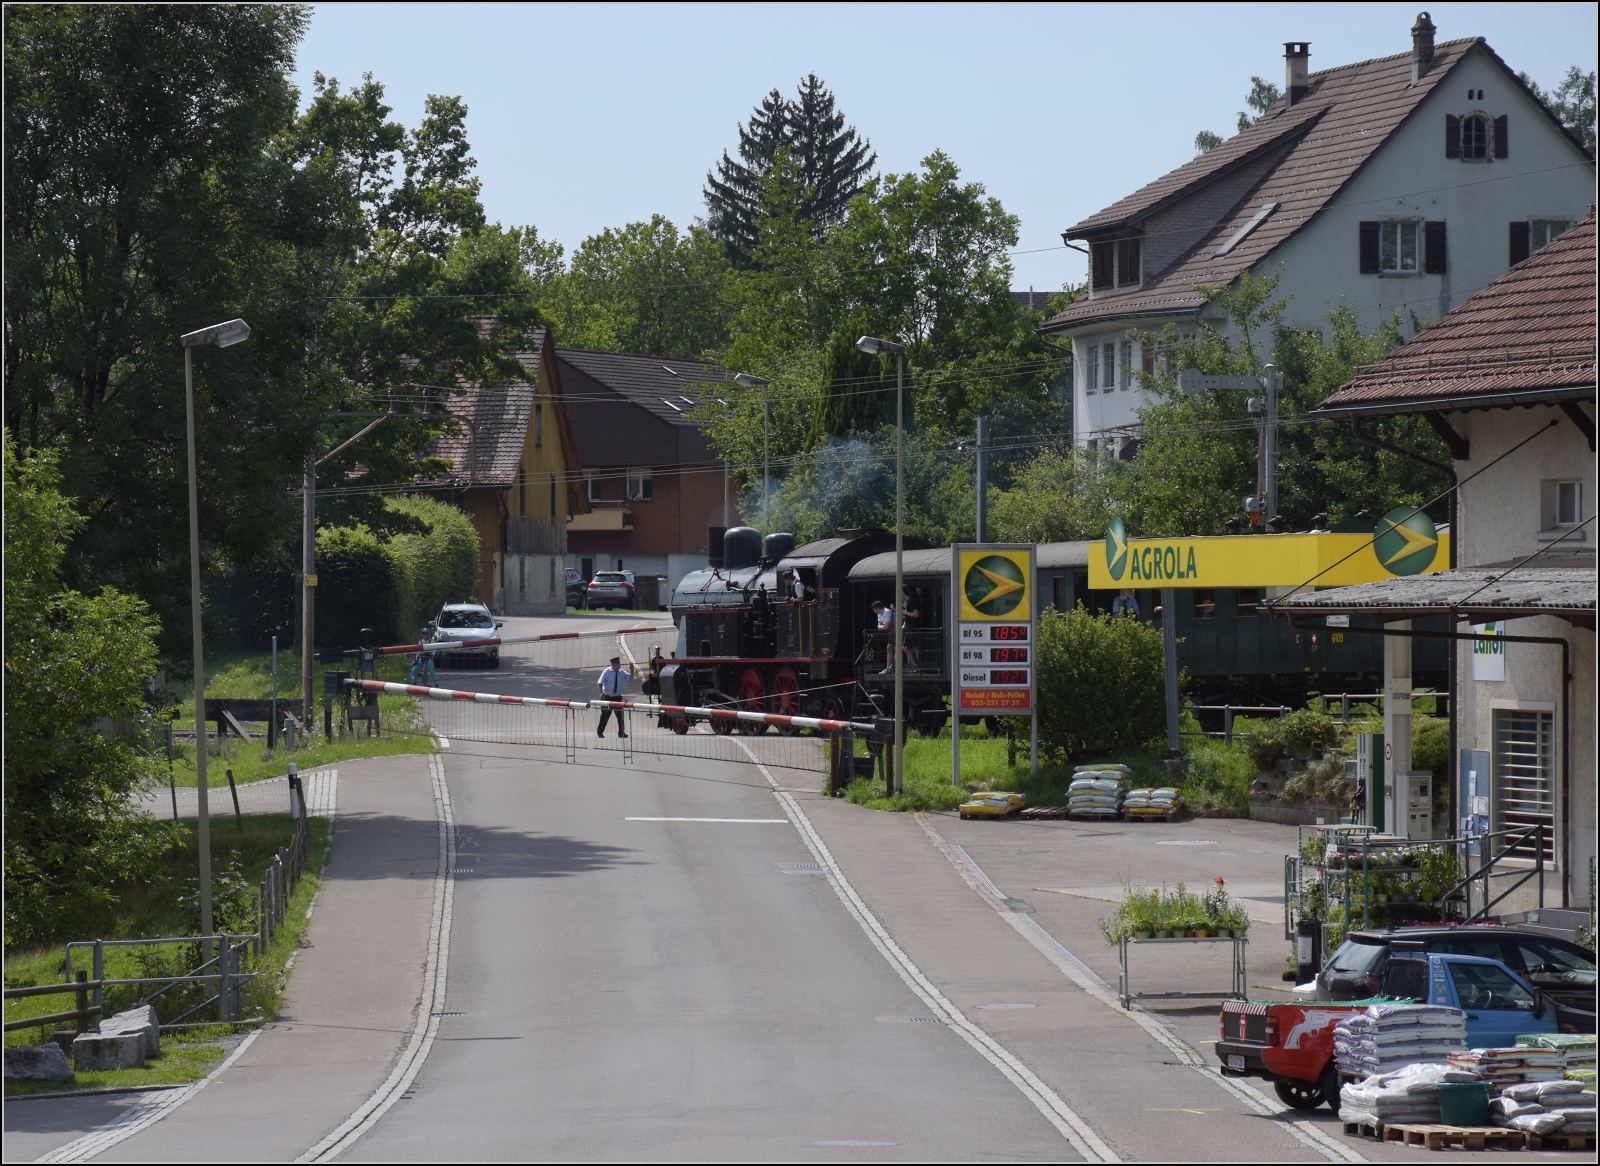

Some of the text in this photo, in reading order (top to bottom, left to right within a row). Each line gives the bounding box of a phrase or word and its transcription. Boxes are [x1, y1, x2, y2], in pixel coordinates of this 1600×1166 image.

[1130, 546, 1197, 580] AGROLA
[963, 630, 983, 638] Bf 95
[1332, 633, 1344, 643] 6109
[963, 652, 983, 660] Bf 98
[963, 673, 986, 682] Diesel
[965, 691, 986, 699] Heizöl
[991, 691, 1026, 699] Holz-Pellet
